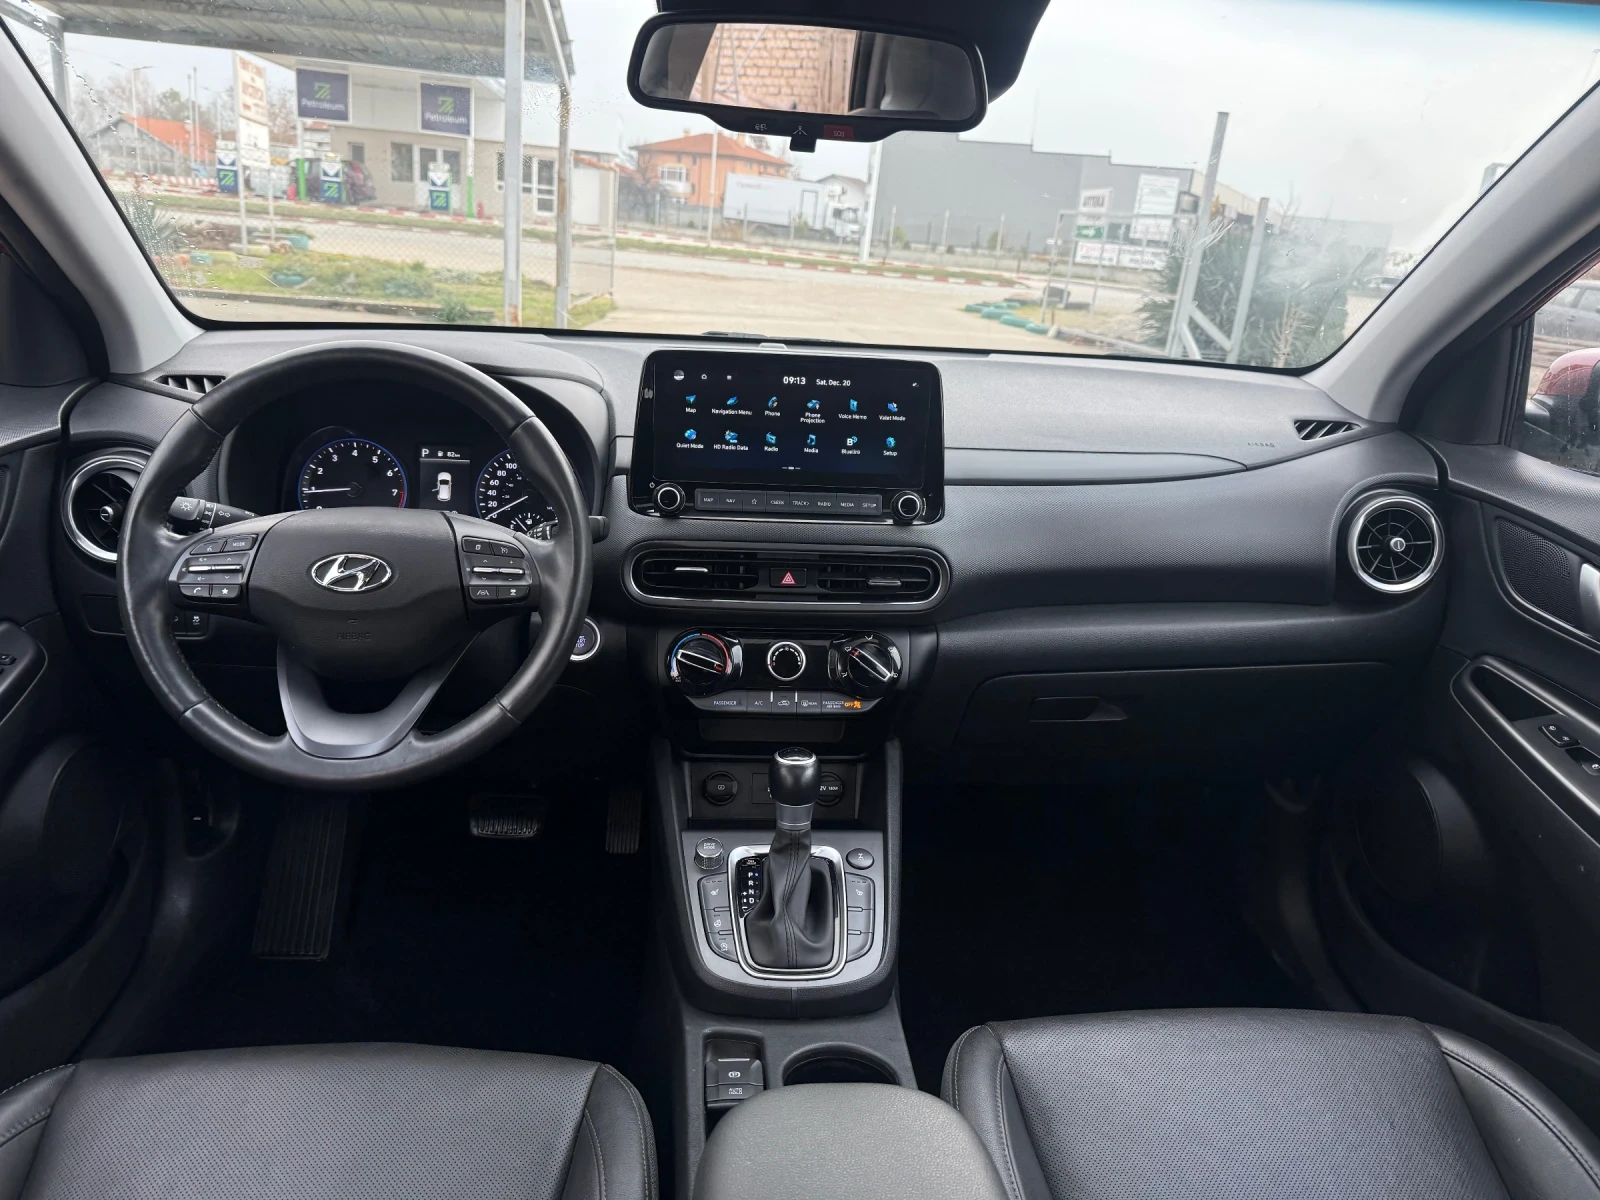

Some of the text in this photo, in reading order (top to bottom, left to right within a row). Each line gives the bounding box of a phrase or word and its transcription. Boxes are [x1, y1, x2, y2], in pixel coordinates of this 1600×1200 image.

[301, 98, 346, 111] Petroleum
[424, 111, 468, 125] Petroleum
[833, 130, 845, 138] SOS
[783, 376, 806, 385] 09:13
[711, 408, 738, 416] Navigation
[421, 448, 430, 458] P
[331, 454, 338, 462] 3
[372, 455, 379, 463] 5
[317, 467, 323, 475] 2
[387, 469, 393, 477] 6
